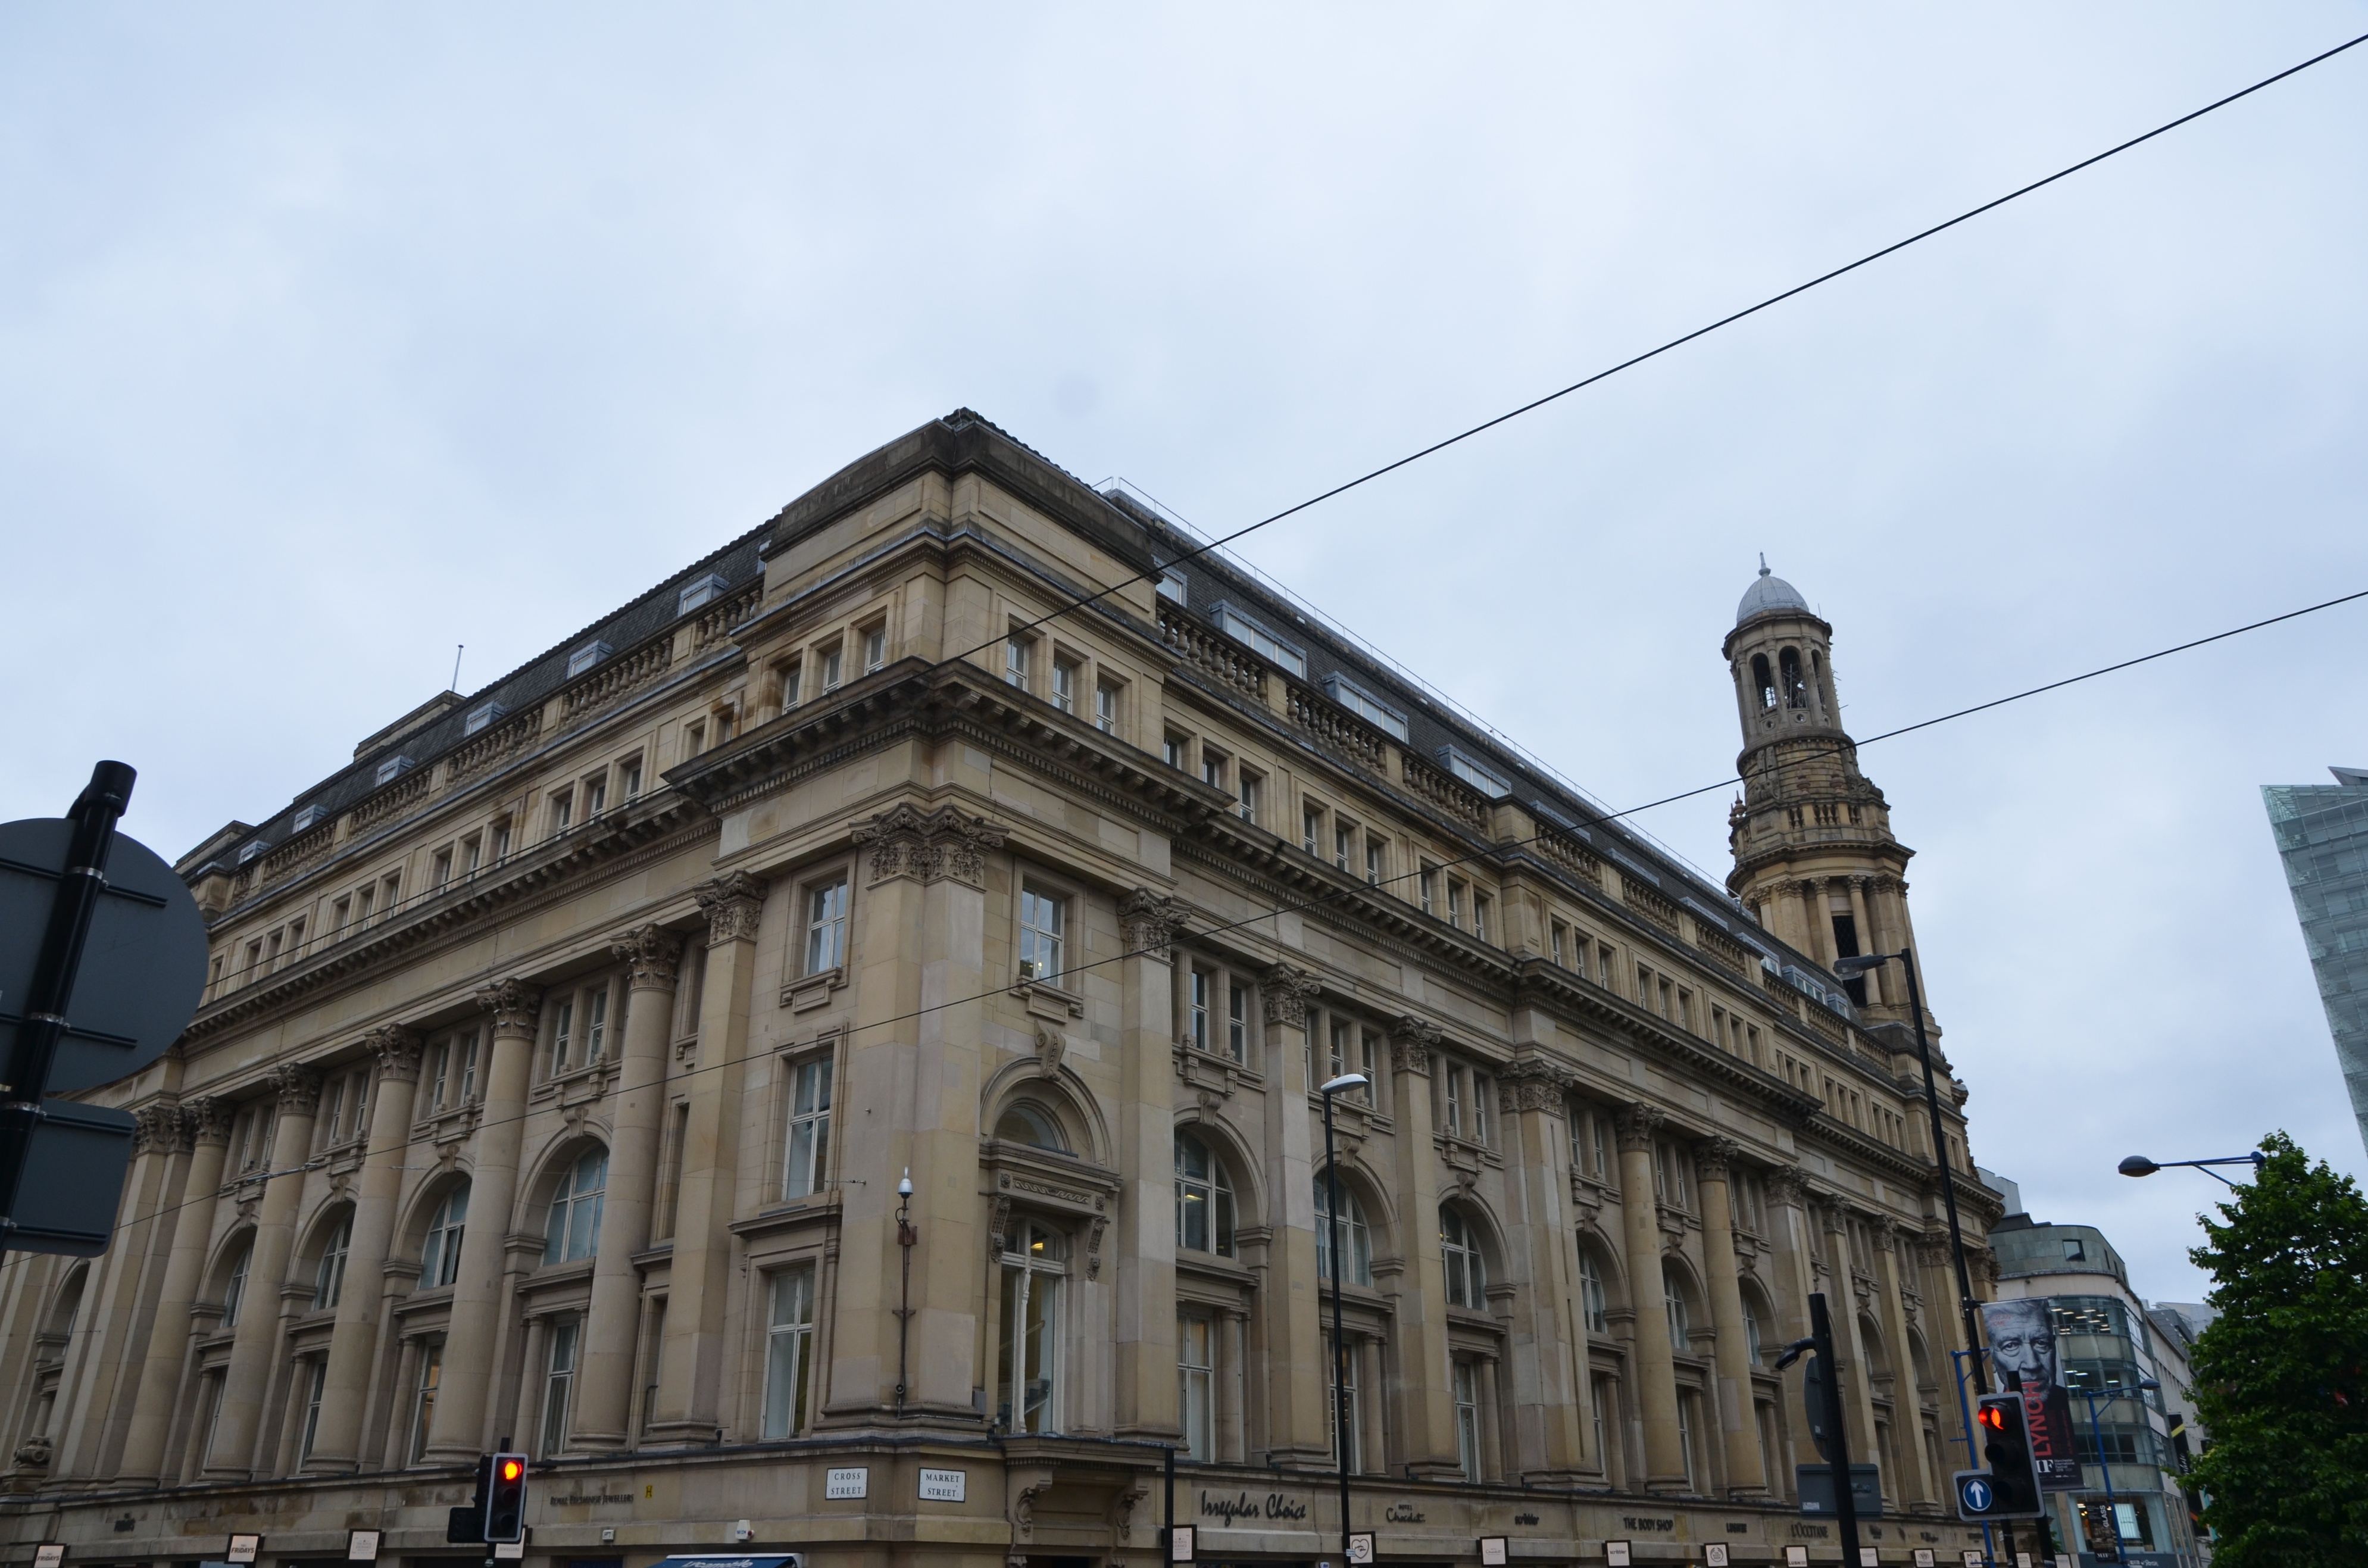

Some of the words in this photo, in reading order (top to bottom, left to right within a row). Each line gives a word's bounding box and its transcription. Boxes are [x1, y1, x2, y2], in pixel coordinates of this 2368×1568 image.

[2021, 1382, 2052, 1456] LYNCH
[926, 1473, 960, 1482] MARKET
[645, 1485, 652, 1498] H
[927, 1488, 956, 1497] STREET
[602, 1494, 634, 1505] JEWELLERS
[1201, 1489, 1260, 1528] Irregular
[1266, 1494, 1306, 1520] Choice
[1515, 1513, 1539, 1525] scribbler
[2100, 1505, 2110, 1528] GLASS
[1623, 1517, 1637, 1530] THE
[1638, 1518, 1655, 1531] BODY
[1657, 1519, 1673, 1532] SHOP
